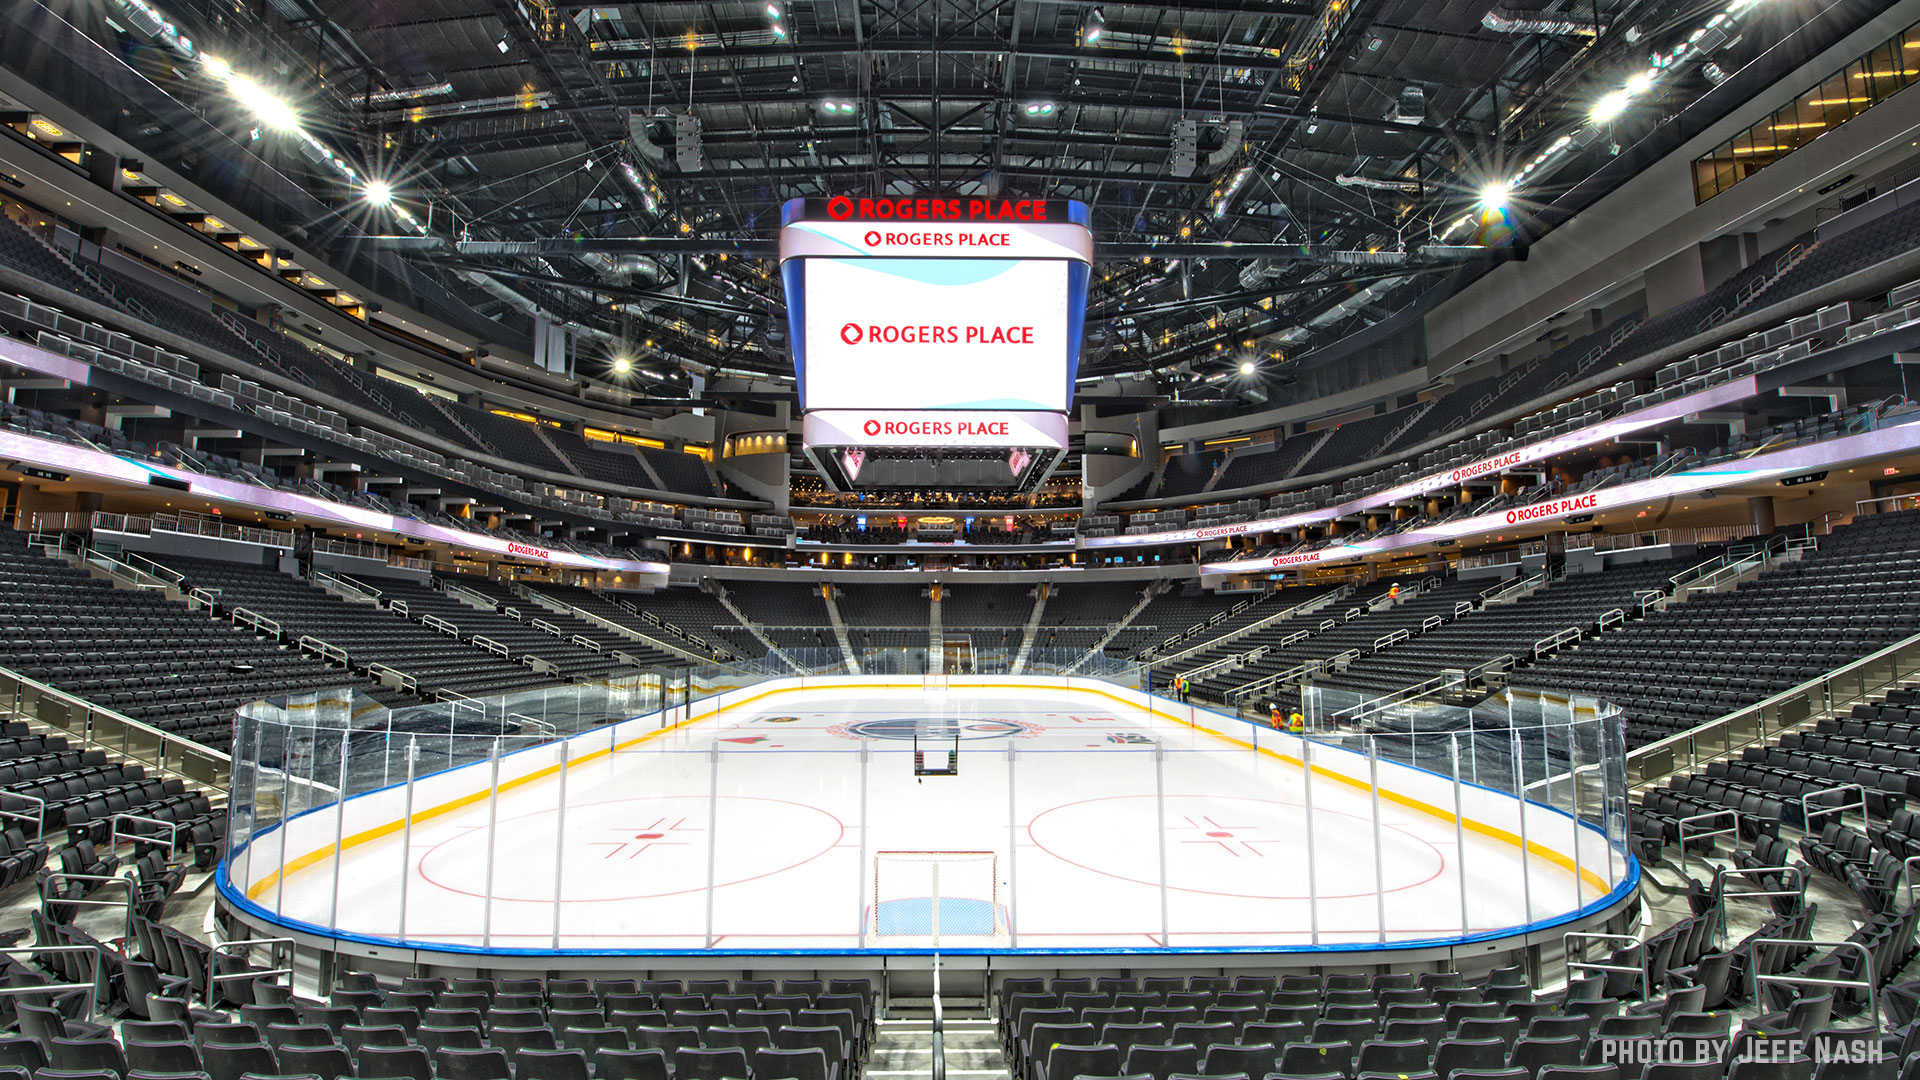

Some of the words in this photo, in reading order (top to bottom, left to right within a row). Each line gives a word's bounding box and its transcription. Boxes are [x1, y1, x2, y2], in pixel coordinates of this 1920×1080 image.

[860, 199, 961, 220] ROGERS
[970, 199, 1046, 220] PLACE
[885, 232, 953, 246] ROGERS
[959, 233, 1010, 247] PLACE
[869, 326, 958, 343] ROGERS
[967, 326, 1034, 344] PLACE
[885, 422, 952, 435] ROGERS
[958, 422, 1009, 436] PLACE
[1461, 461, 1492, 479] ROGERS
[1494, 452, 1521, 468] PLACE
[1518, 503, 1559, 520] ROGERS
[1561, 494, 1598, 513] PLACE
[1204, 528, 1228, 537] ROGERS
[1229, 526, 1248, 534] PLACE
[514, 544, 534, 556] ROGERS
[535, 549, 549, 559] PLACE
[1279, 555, 1302, 565] ROGERS
[1303, 552, 1320, 562] PLACE
